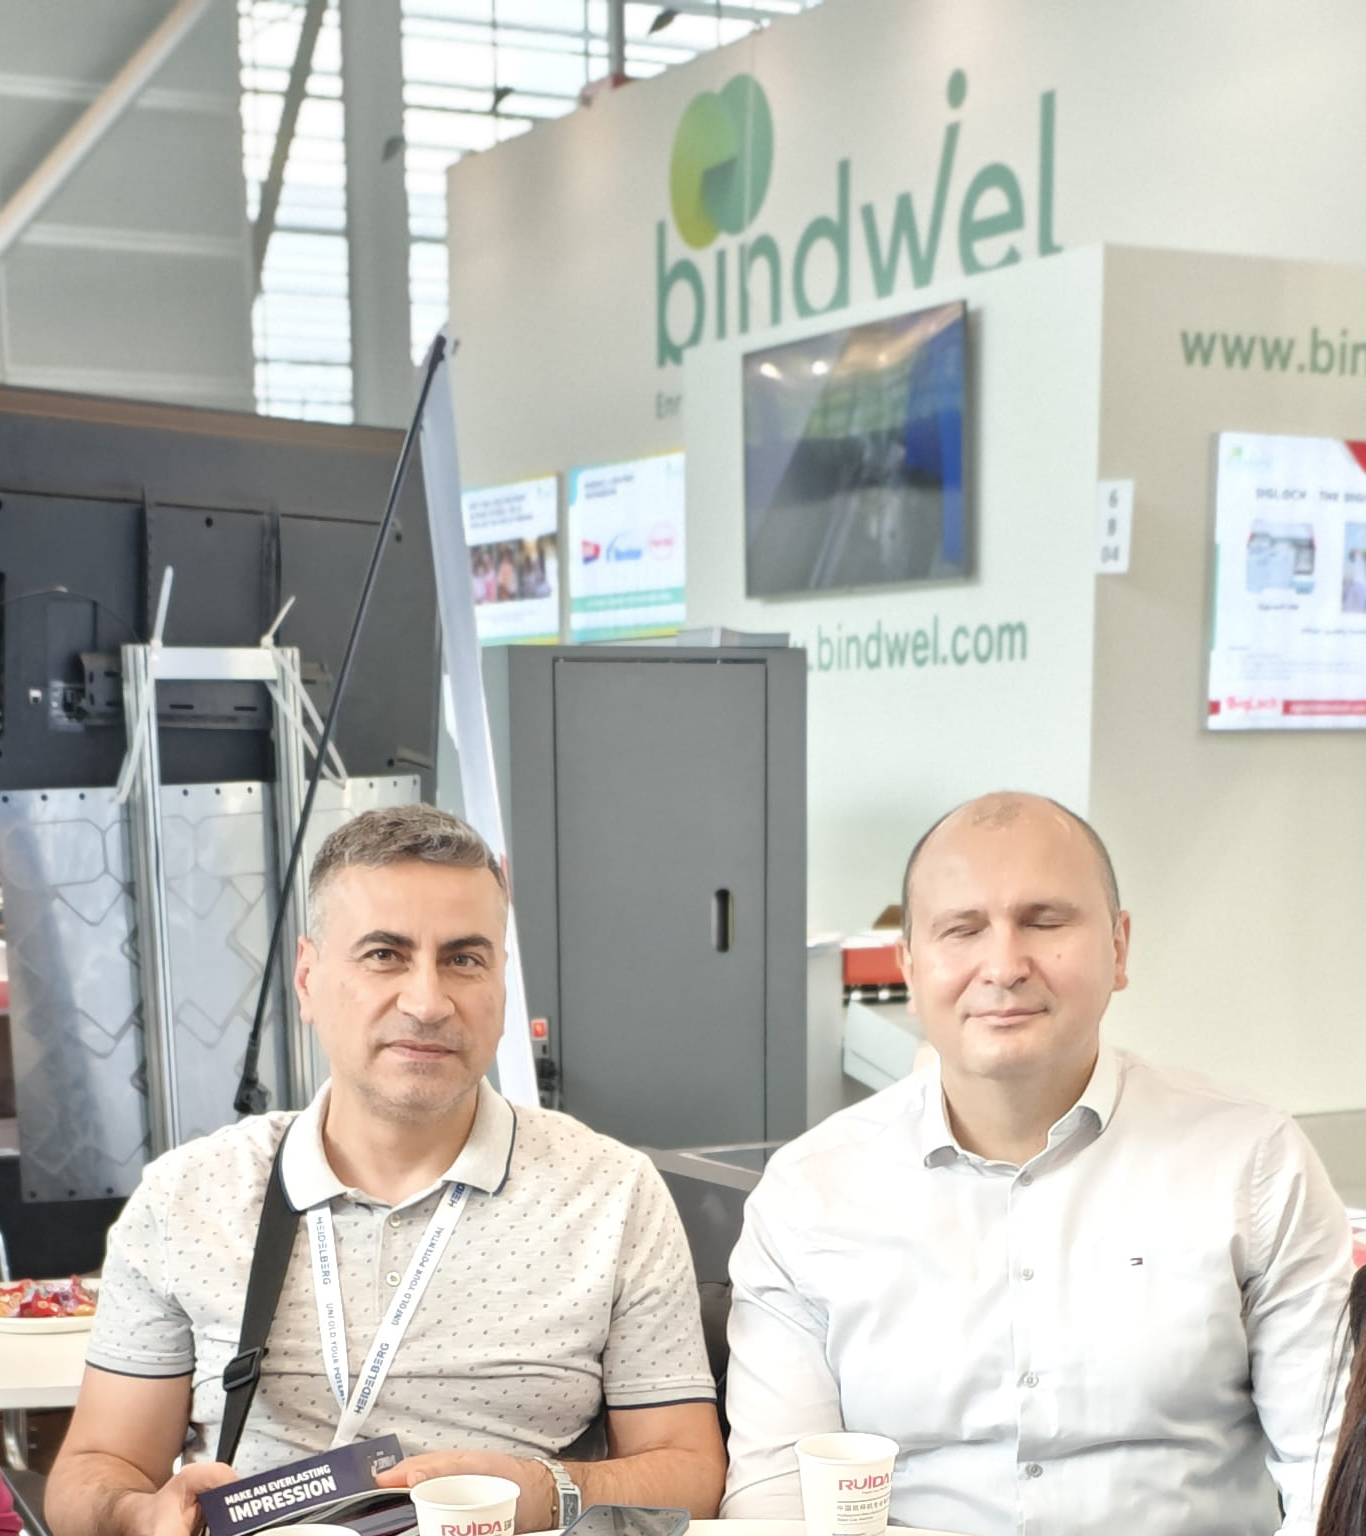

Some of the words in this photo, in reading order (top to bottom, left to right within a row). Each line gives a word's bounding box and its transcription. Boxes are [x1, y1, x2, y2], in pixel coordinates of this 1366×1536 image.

[656, 68, 1064, 368] bindwel
[315, 1216, 332, 1286] HEIDELBERG
[325, 1302, 338, 1339] UNFOLD
[353, 1342, 390, 1415] HEIDELBERG
[391, 1292, 412, 1327] UNFOLD
[409, 1268, 423, 1291] YOUR
[419, 1226, 445, 1268] POTENTIAL
[224, 1488, 253, 1507] MAKE
[253, 1484, 269, 1497] AN
[267, 1464, 332, 1494] EVERLASTING
[227, 1475, 338, 1524] IMPRESSION
[441, 1521, 502, 1536] RUIDA
